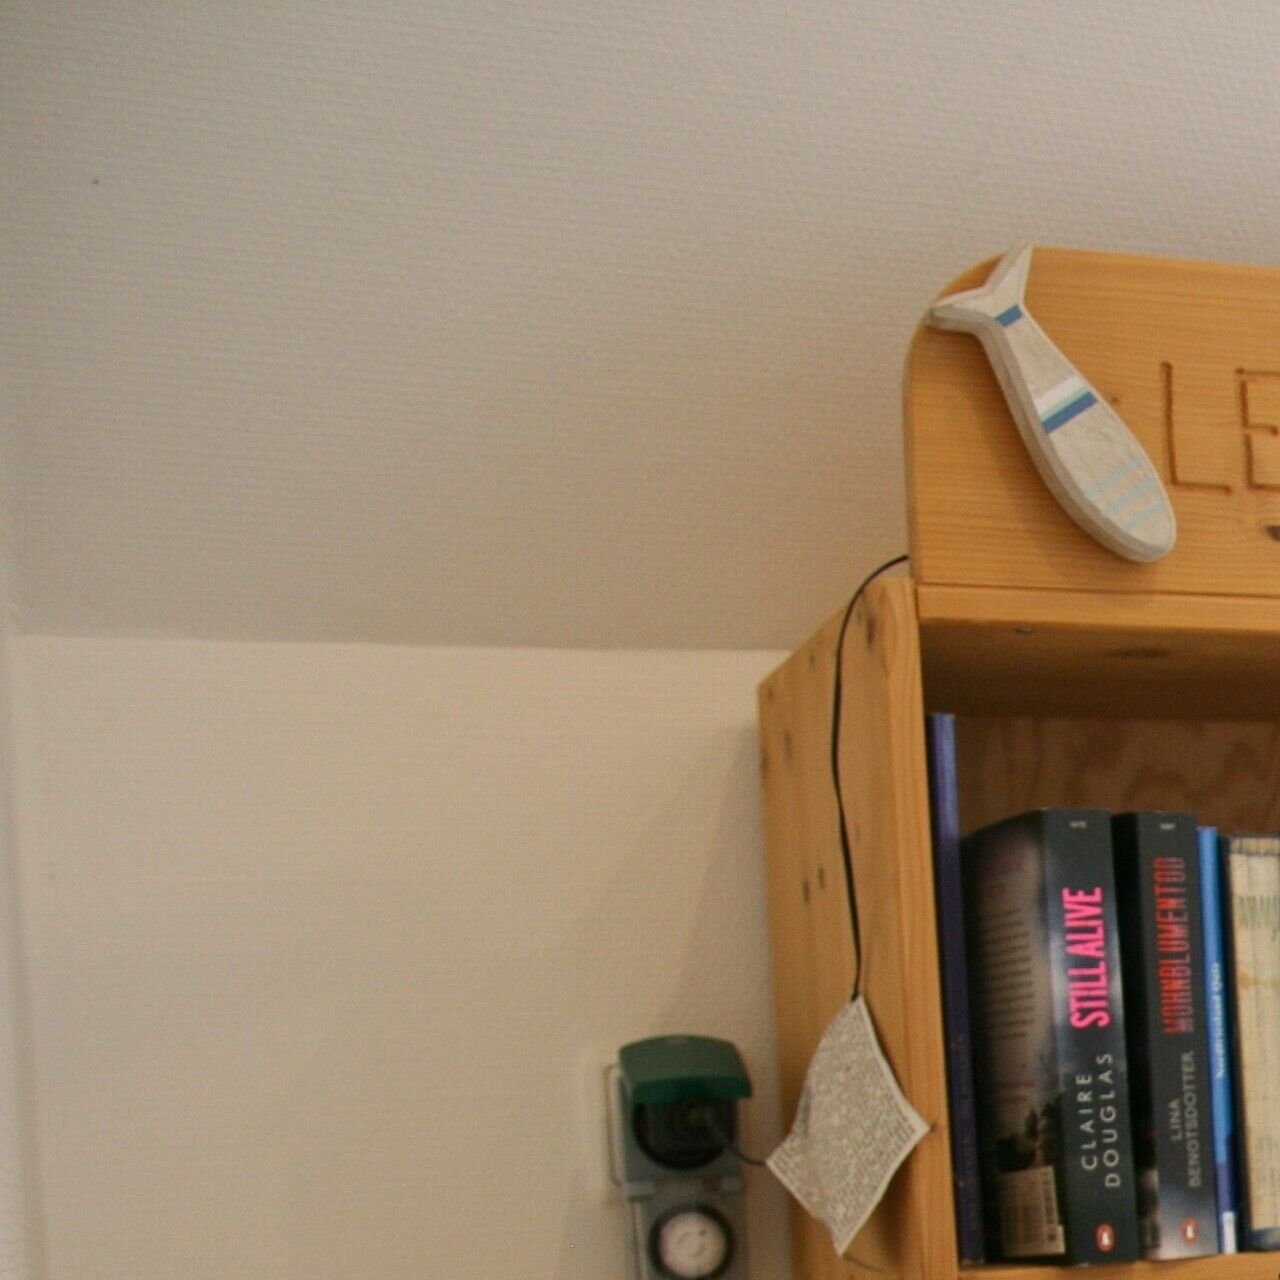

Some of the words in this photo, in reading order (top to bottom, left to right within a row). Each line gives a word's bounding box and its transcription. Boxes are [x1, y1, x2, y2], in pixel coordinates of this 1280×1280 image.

[1062, 887, 1108, 957] ALIVE
[1153, 857, 1195, 1034] MOHNBLUMENTOD
[1068, 959, 1113, 1029] STILL
[1076, 1073, 1098, 1171] CLAIRE
[1096, 1052, 1122, 1187] DOUGLAS
[1168, 1098, 1183, 1141] LINA
[1180, 1051, 1203, 1187] BENGTSDOTTER
